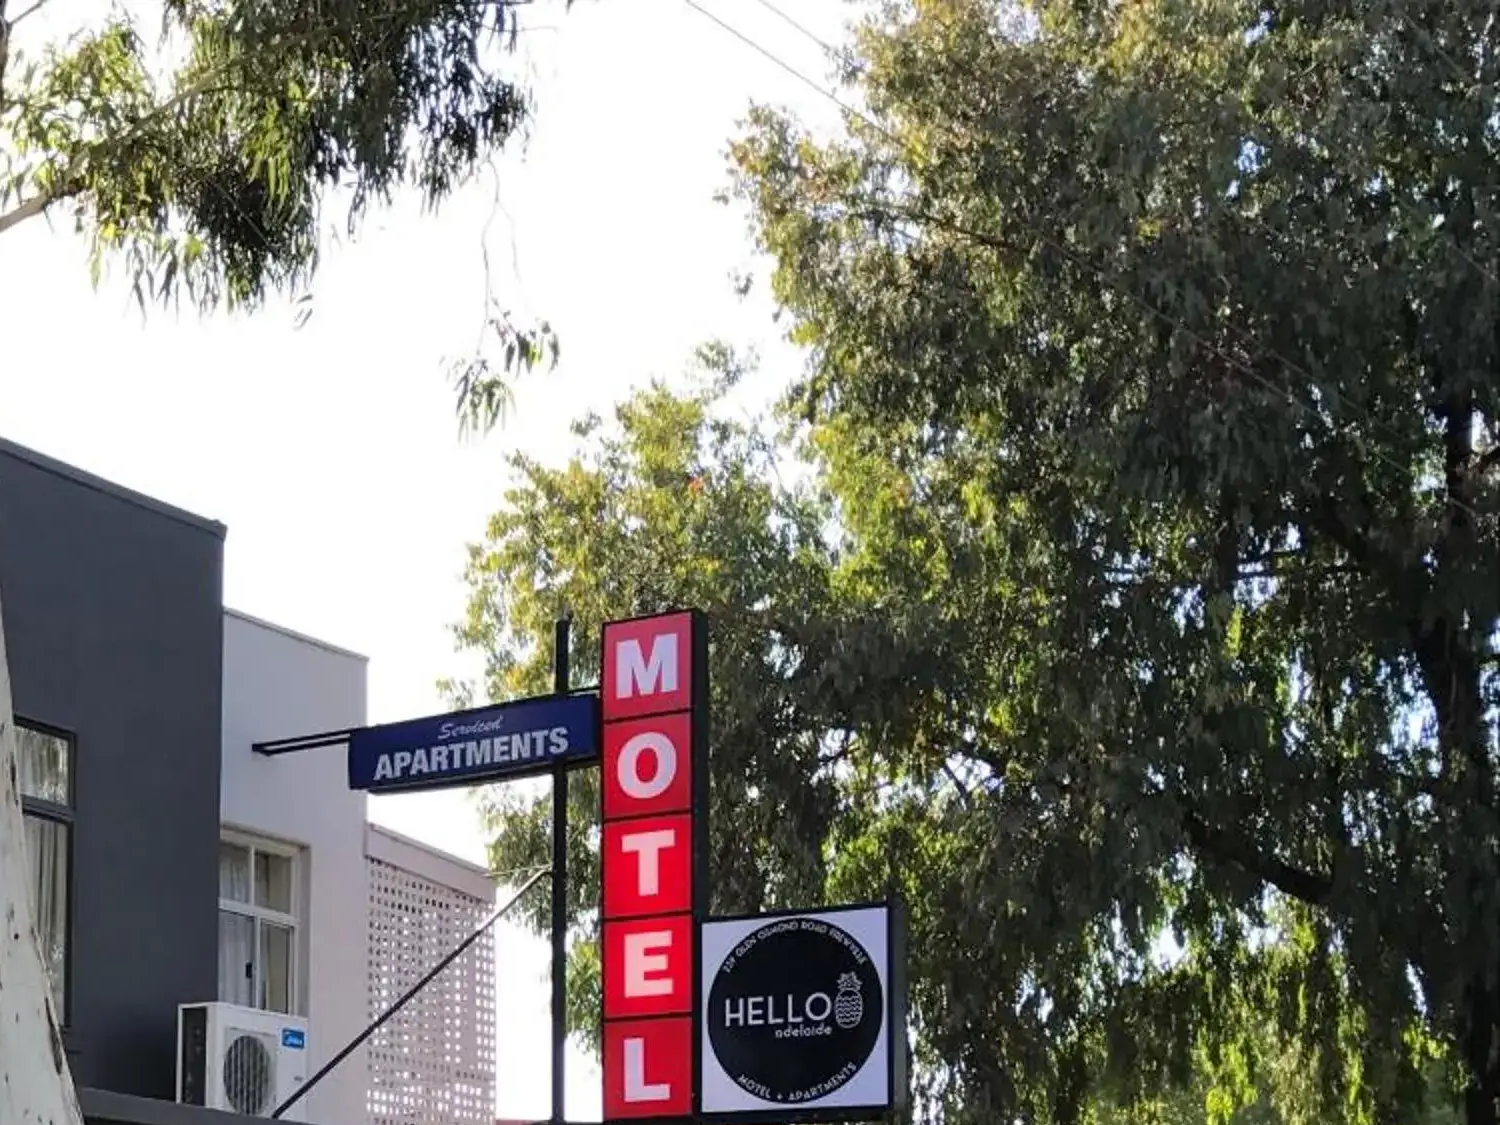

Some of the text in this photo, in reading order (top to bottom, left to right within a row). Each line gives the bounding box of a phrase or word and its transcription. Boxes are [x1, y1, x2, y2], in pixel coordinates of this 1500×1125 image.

[373, 727, 570, 780] APARTMENTS
[615, 633, 678, 1103] MOTEL
[801, 920, 828, 934] ROAD
[724, 991, 832, 1027] HELLO
[775, 1022, 833, 1038] adelaide
[738, 1073, 771, 1099] MOTEL
[788, 1061, 857, 1101] APARTMENTS
